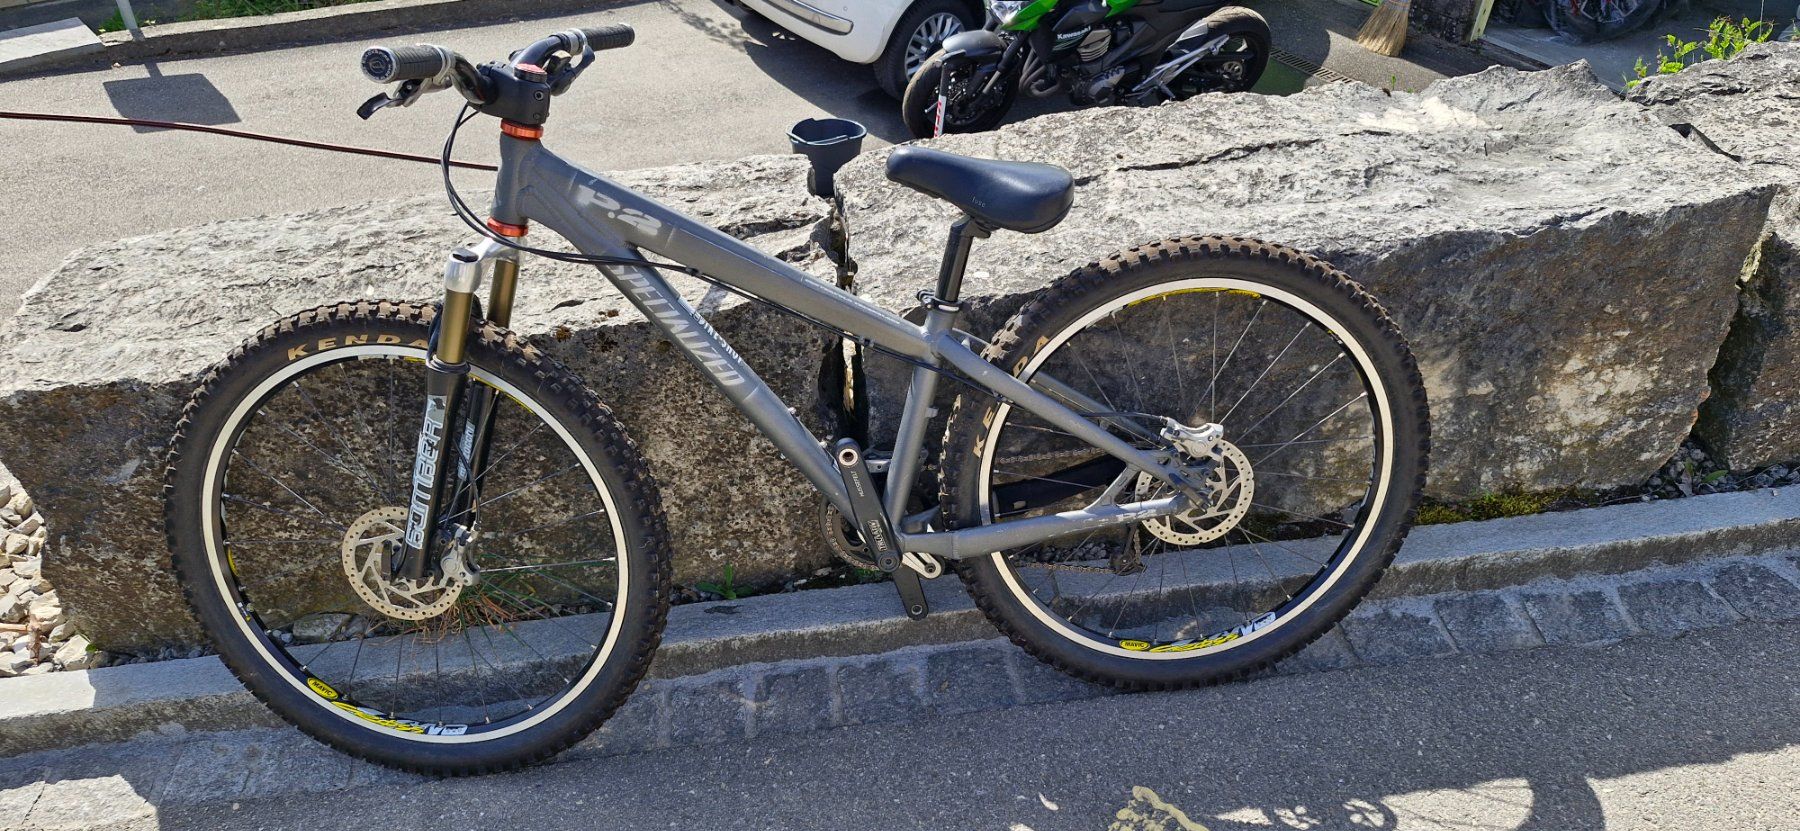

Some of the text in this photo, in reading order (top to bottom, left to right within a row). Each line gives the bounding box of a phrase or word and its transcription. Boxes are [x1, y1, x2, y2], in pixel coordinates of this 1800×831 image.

[1057, 25, 1091, 40] Kawasaki
[287, 334, 428, 361] KENDA
[972, 336, 1049, 459] KEDA
[311, 680, 334, 696] MAVIC
